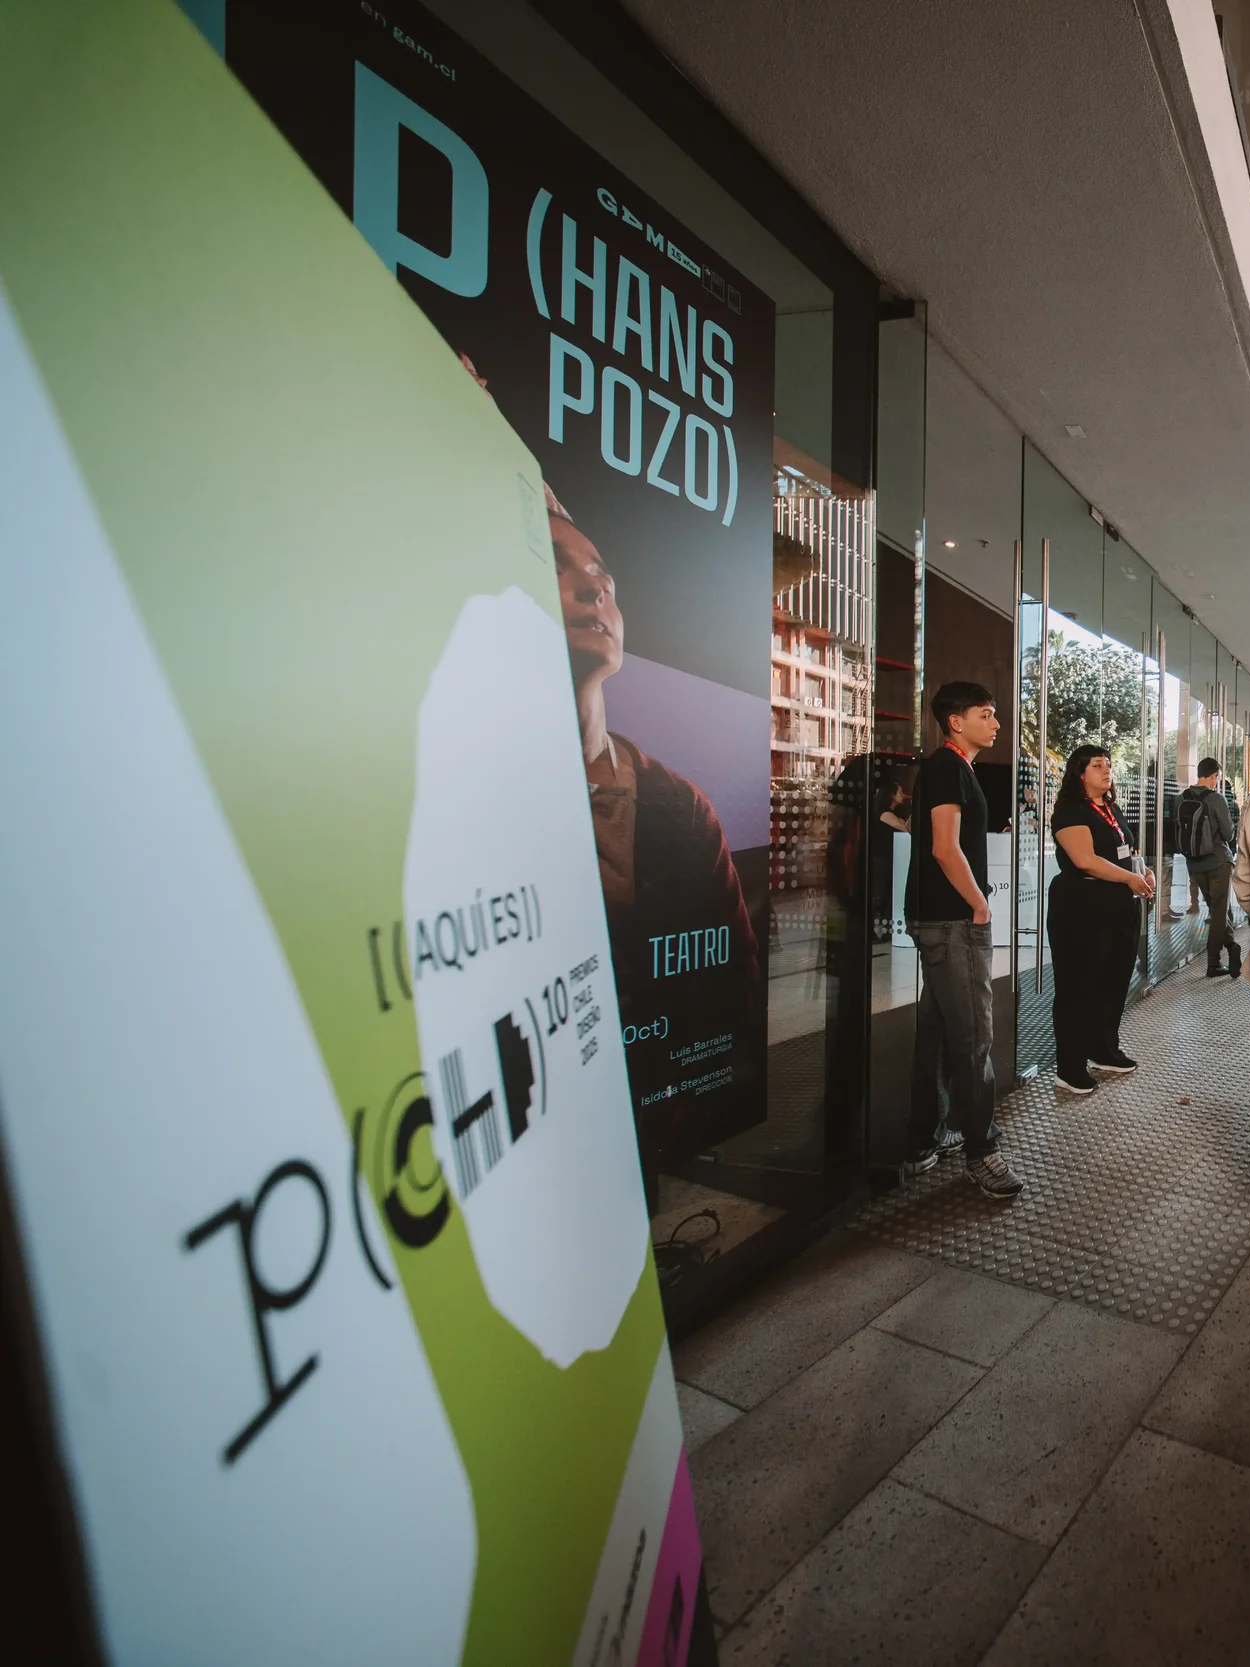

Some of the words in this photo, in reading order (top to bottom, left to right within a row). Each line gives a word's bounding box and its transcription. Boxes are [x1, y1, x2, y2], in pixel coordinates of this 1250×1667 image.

[360, 1, 387, 27] en
[393, 26, 456, 82] gam.cl
[671, 248, 682, 262] 15
[682, 258, 698, 274] años
[527, 187, 734, 418] (HANS
[548, 332, 739, 527] POZO)
[649, 925, 730, 979] TEATRO
[670, 1046, 691, 1060] Luis
[694, 1033, 733, 1052] Barrales
[681, 1042, 733, 1066] DRAMATURGIA
[680, 1065, 733, 1091] Stevenson
